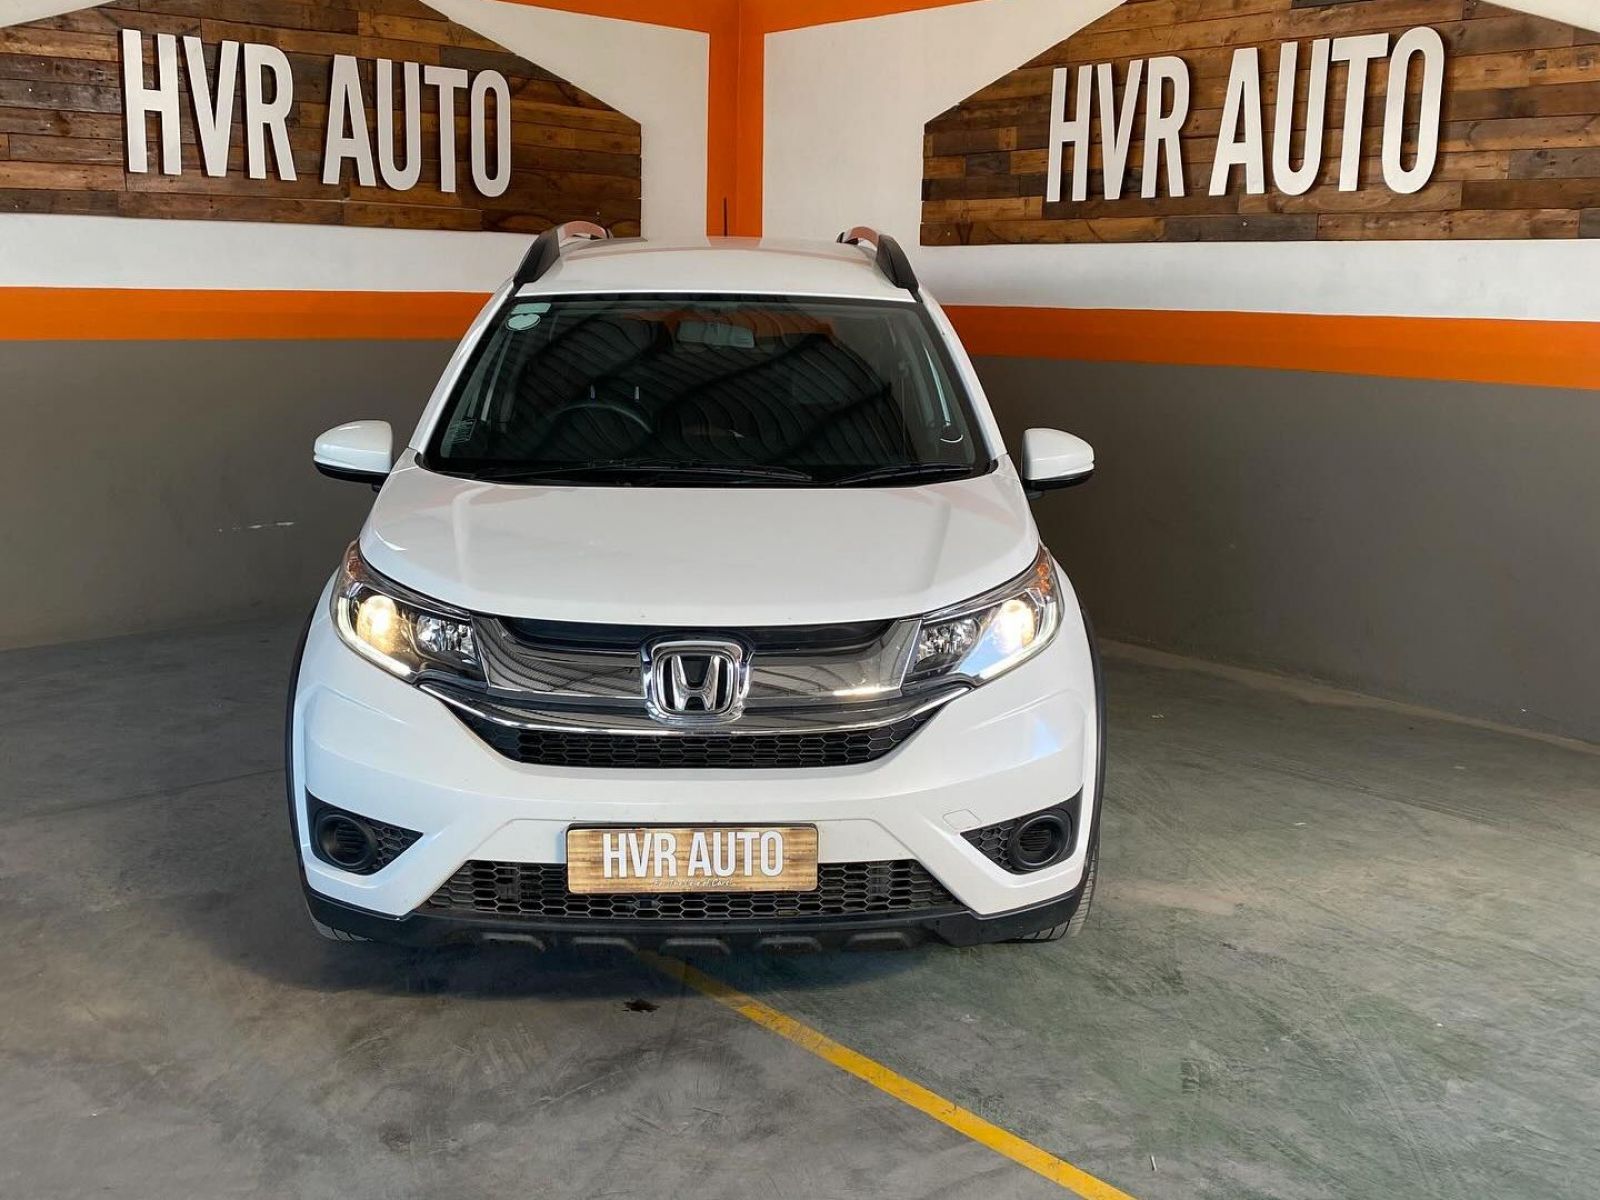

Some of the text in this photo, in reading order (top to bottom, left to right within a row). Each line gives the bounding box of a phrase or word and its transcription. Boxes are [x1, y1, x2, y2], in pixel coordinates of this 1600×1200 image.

[121, 28, 512, 198] HVR AUTO
[1045, 26, 1446, 202] HVR AUTO
[603, 830, 784, 878] HVR AUTO
